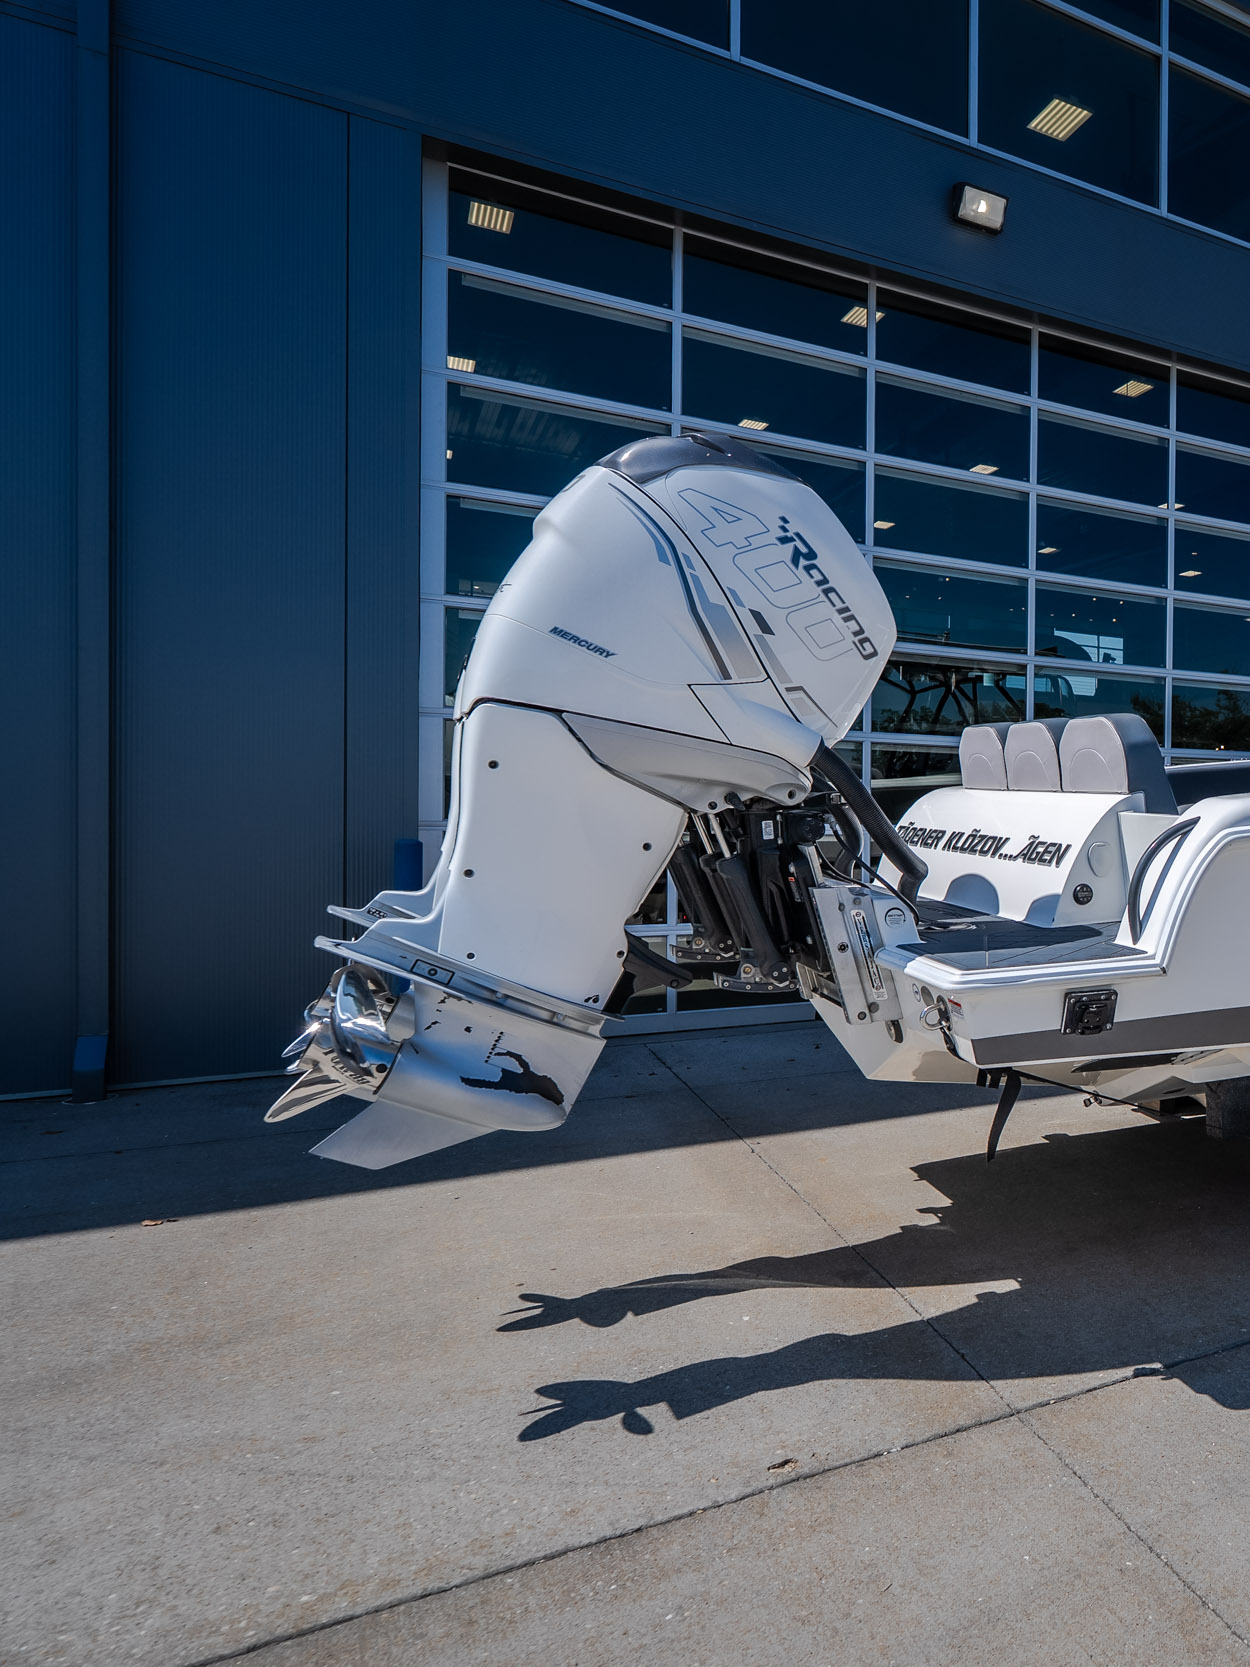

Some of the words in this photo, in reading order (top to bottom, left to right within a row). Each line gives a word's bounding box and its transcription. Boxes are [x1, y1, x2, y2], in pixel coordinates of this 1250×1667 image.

[677, 487, 854, 662] 400
[775, 530, 880, 661] Racing
[548, 625, 618, 660] MERCURY
